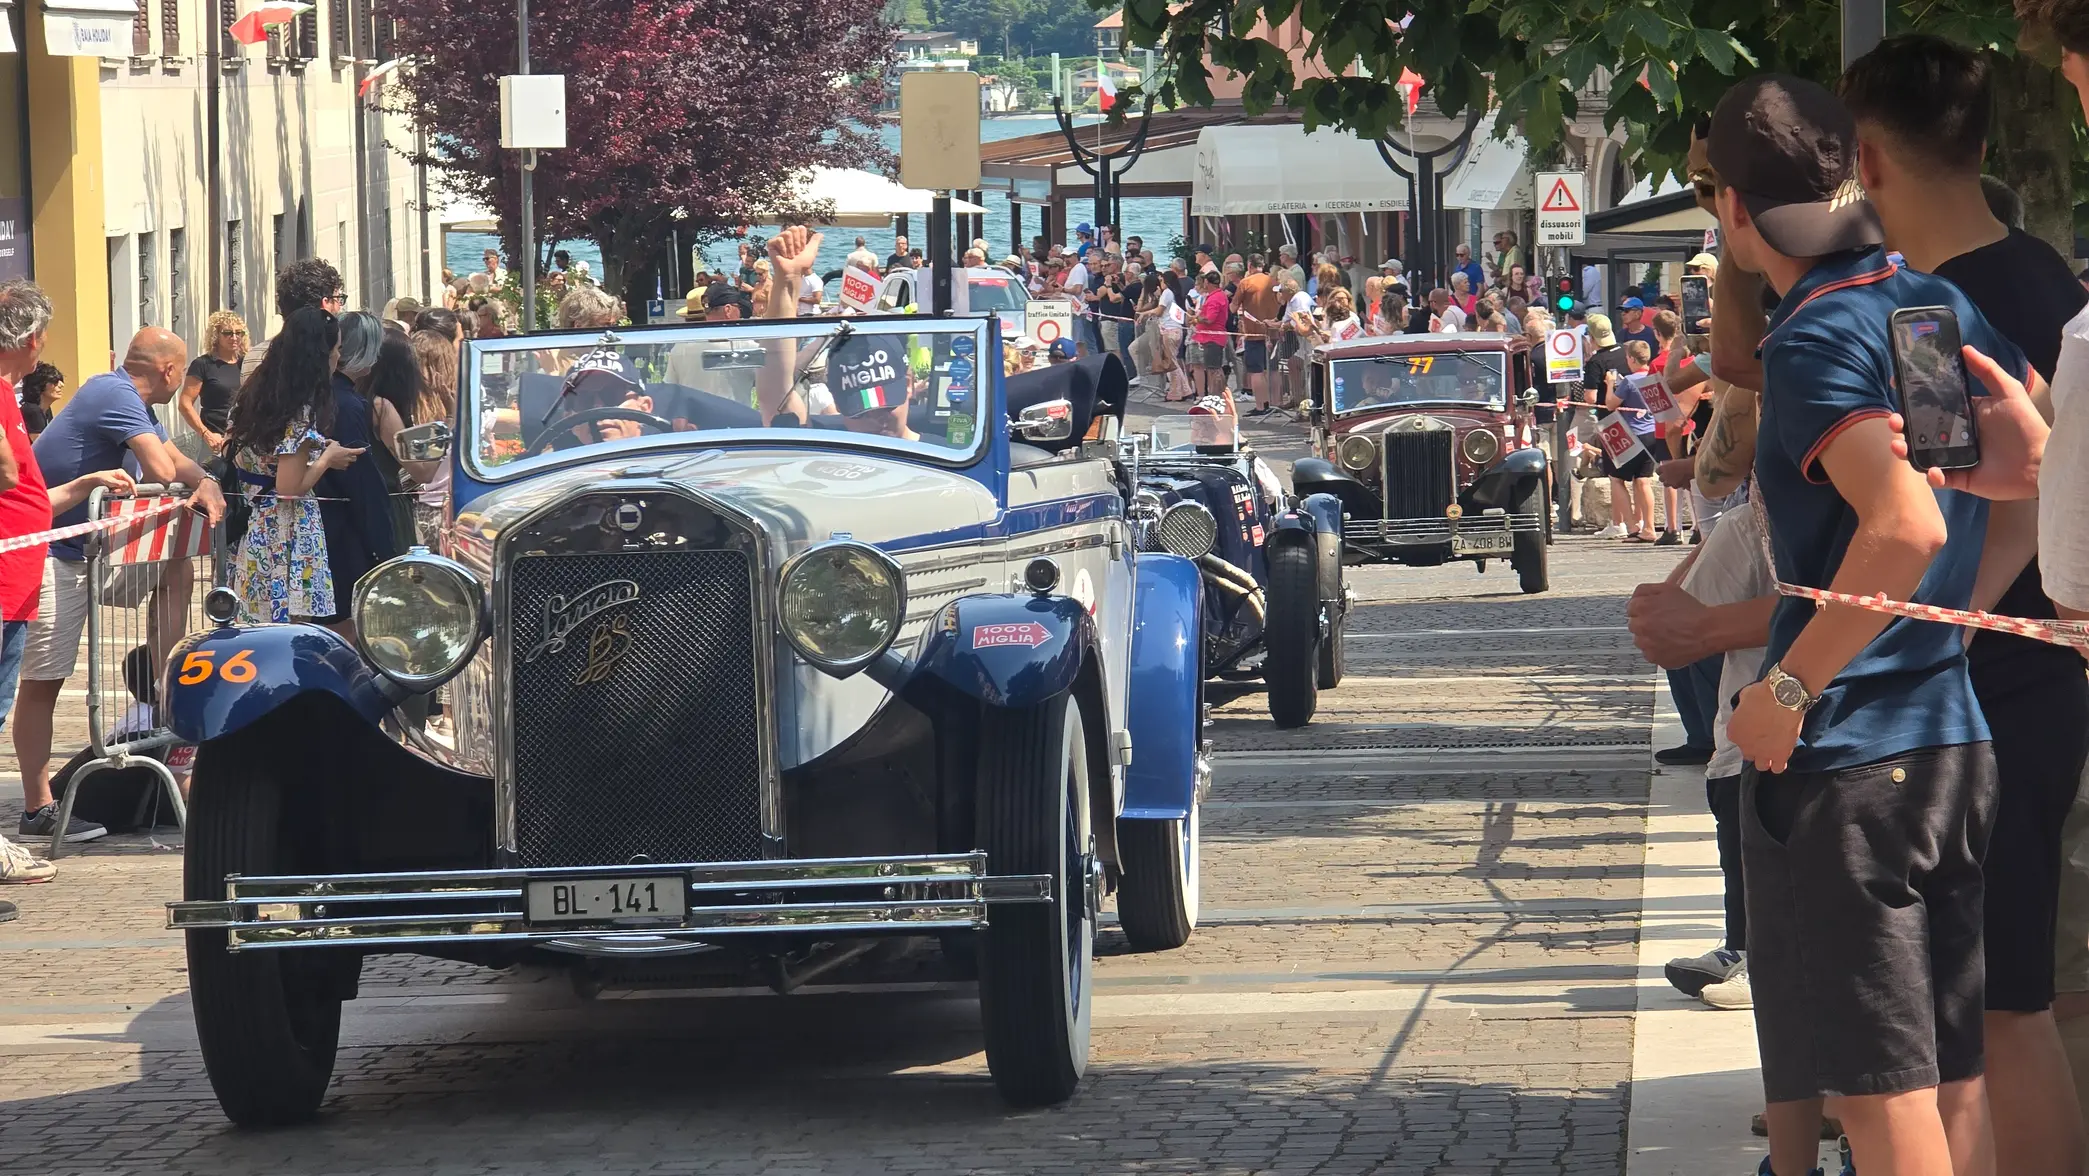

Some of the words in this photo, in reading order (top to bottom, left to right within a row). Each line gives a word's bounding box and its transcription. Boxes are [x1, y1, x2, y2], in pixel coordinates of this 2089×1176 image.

[1267, 202, 1307, 210] GELATERIA
[1325, 201, 1361, 209] ICECREAM
[1540, 219, 1581, 229] dissuasori
[1548, 231, 1574, 240] mobili
[846, 277, 869, 293] 1000
[843, 286, 866, 303] MIGLIA
[1408, 356, 1434, 374] 77
[841, 365, 896, 391] MIGLIA
[1453, 540, 1467, 551] ZA
[1498, 536, 1512, 549] BW
[526, 579, 639, 663] Lancia
[982, 625, 1031, 635] 1000
[978, 634, 1034, 646] MIGLIA
[178, 649, 258, 686] 56
[553, 885, 588, 915] BL
[608, 882, 659, 914] 141
